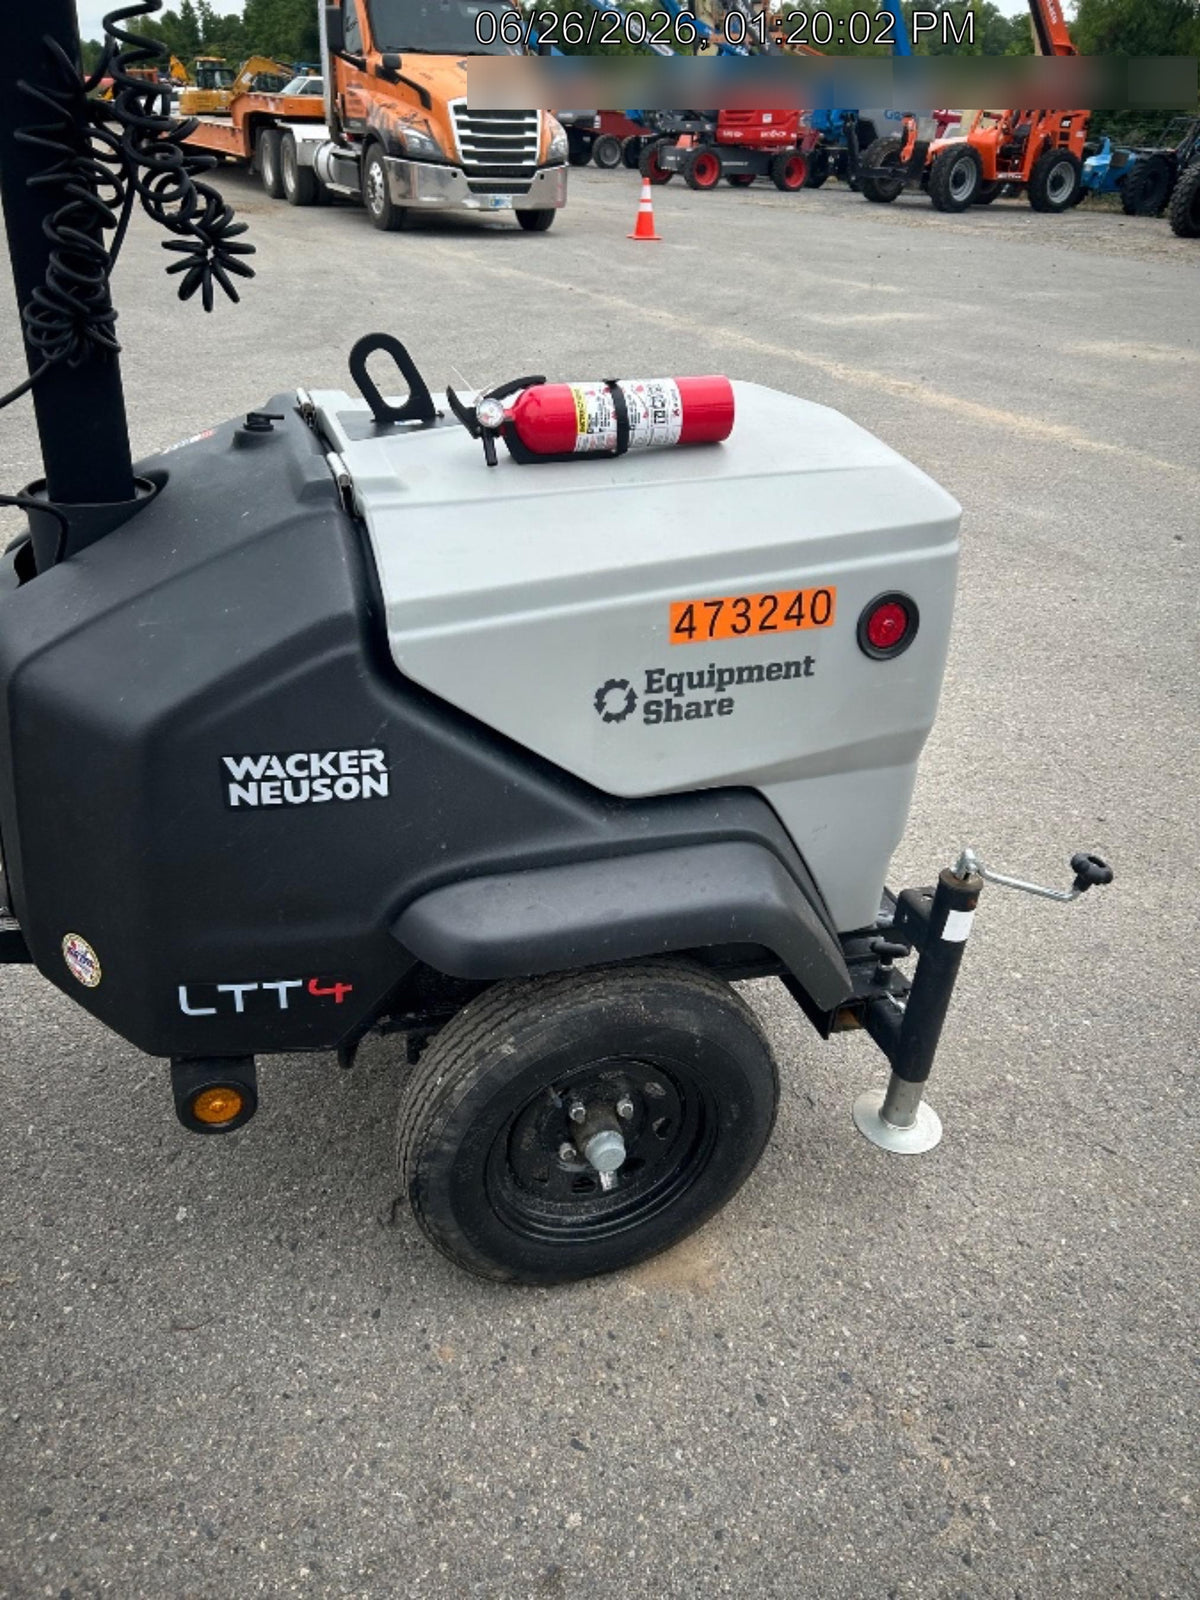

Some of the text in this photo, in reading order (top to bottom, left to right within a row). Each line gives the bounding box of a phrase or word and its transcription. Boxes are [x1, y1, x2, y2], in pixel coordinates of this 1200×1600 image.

[673, 589, 832, 640] 473240
[644, 655, 816, 698] Equipment
[643, 696, 735, 725] Share
[222, 748, 388, 781] WACKER
[228, 772, 390, 807] NEUSON
[178, 977, 353, 1016] LTT4
